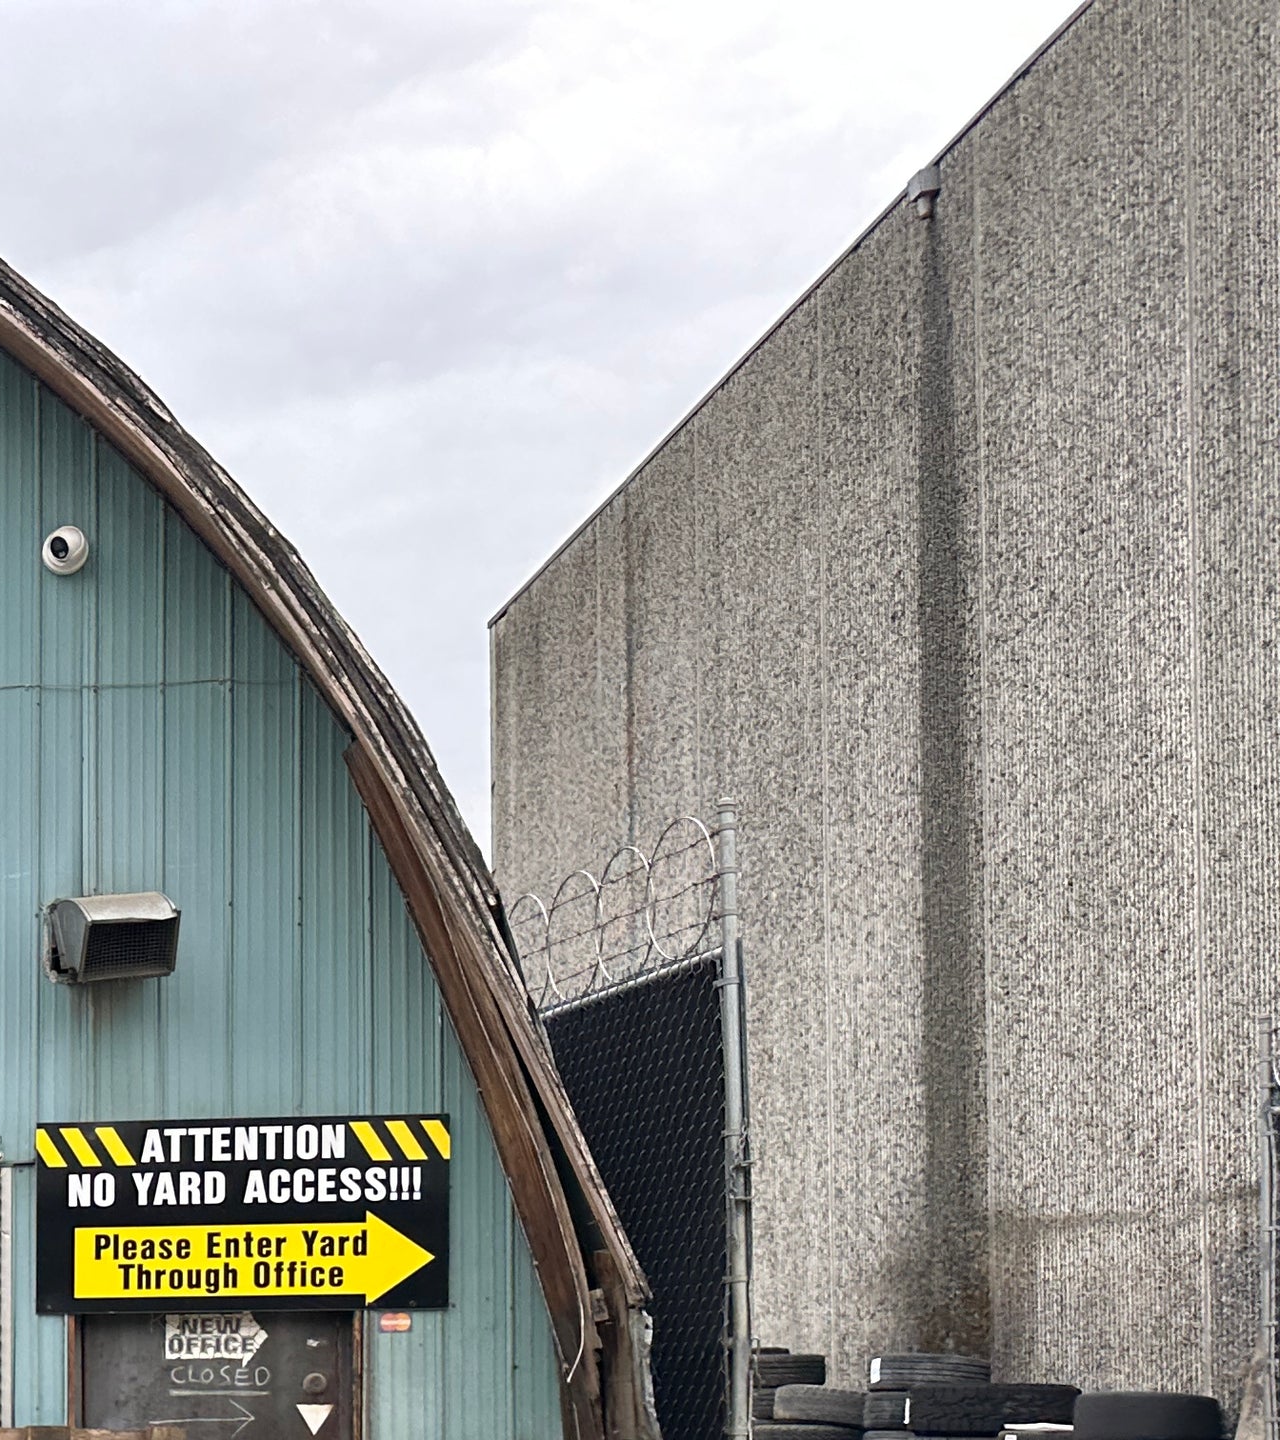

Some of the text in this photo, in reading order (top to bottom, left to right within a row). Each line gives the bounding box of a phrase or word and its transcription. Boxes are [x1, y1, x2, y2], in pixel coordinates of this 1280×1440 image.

[140, 1124, 346, 1163] ATTENTION
[67, 1166, 422, 1208] NO YARD ACCESS!!!
[94, 1229, 368, 1261] Please Enter Yard
[118, 1260, 344, 1293] Through Office
[181, 1316, 241, 1334] NEW
[168, 1333, 256, 1355] OFFICE
[171, 1365, 271, 1386] CLOSED
